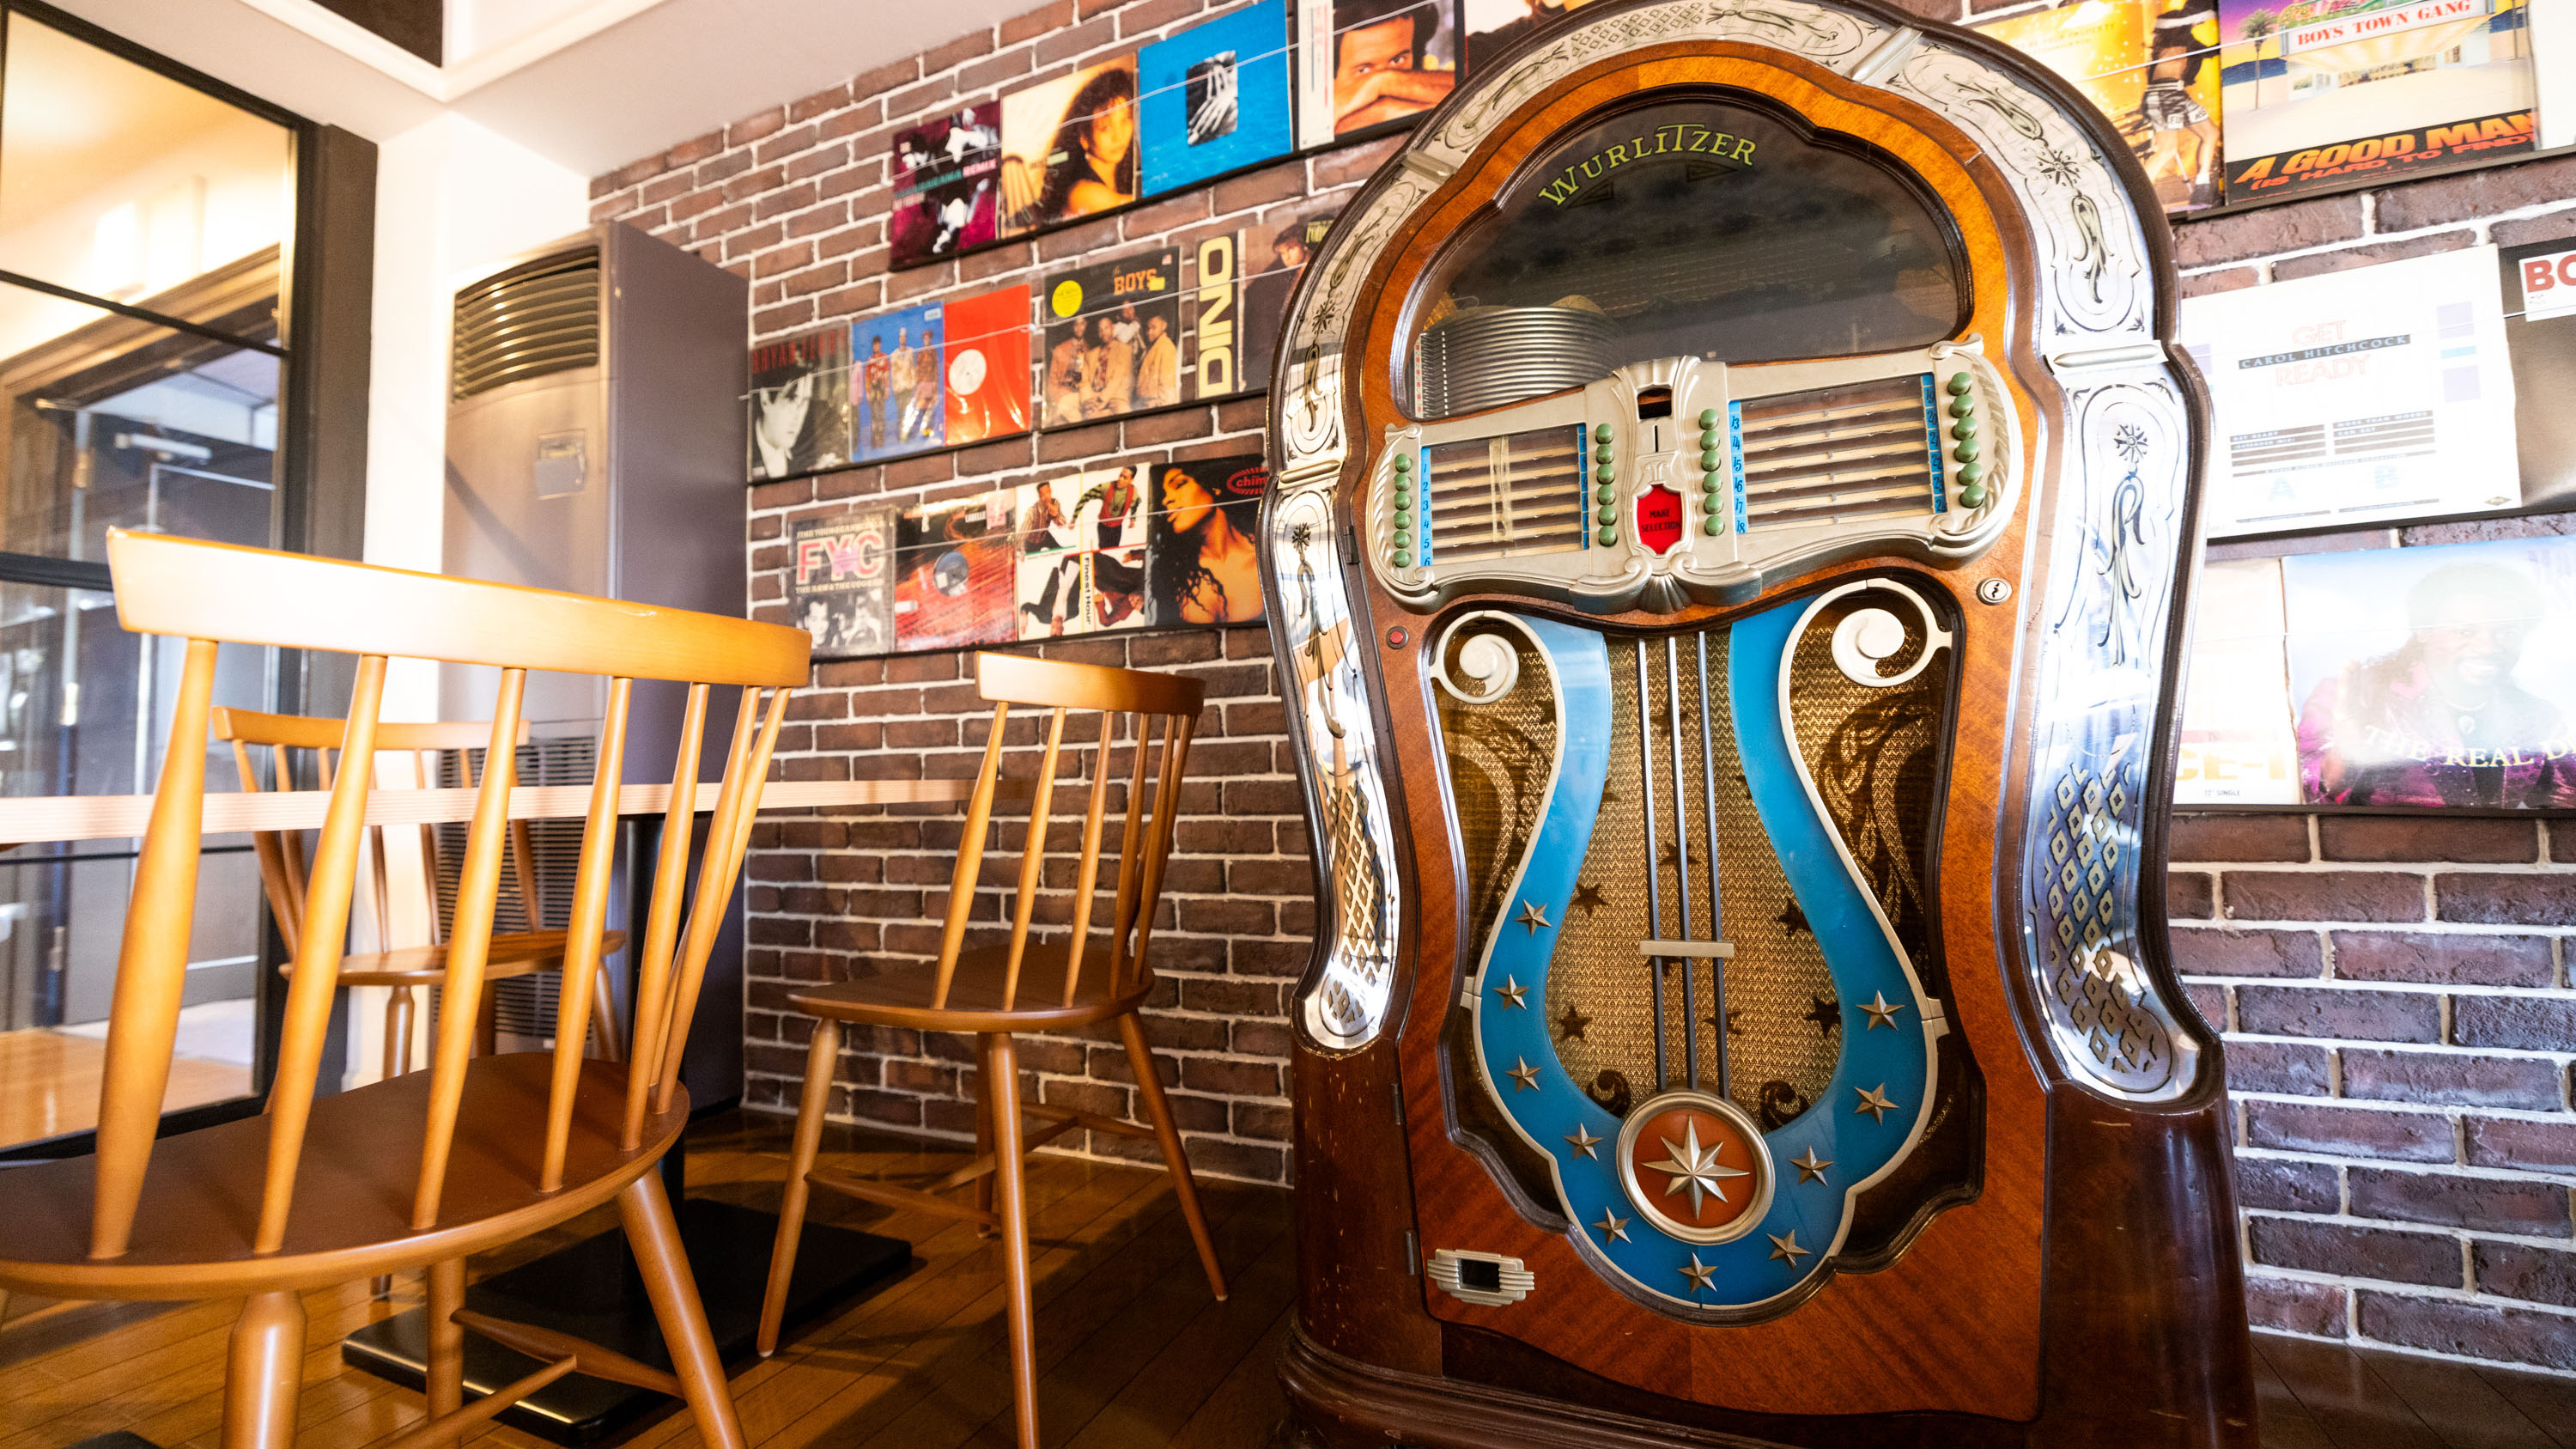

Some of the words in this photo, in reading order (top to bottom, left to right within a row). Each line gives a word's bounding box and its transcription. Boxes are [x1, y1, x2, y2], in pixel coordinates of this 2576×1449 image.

[2298, 26, 2344, 46] BOYS
[2351, 12, 2409, 34] TOWN
[2418, 0, 2470, 21] GANG
[2233, 156, 2276, 184] A
[2281, 133, 2416, 174] GOOD
[2397, 149, 2442, 163] TO
[1539, 125, 1757, 205] WURLITZER
[1114, 268, 1157, 295] BOYS
[1199, 236, 1232, 398] DINO
[2292, 320, 2346, 344] GET
[2241, 353, 2295, 368] CAROL
[2305, 336, 2407, 359] HITCHCOCK
[2276, 354, 2370, 387] READY
[1925, 389, 1935, 404] 19
[1731, 415, 1740, 430] 13
[1927, 411, 1937, 425] 20
[1732, 435, 1741, 450] 14
[1929, 432, 1939, 447] 21
[1424, 464, 1427, 473] 1
[1734, 456, 1742, 472] 15
[1423, 481, 1429, 492] 2
[1735, 477, 1743, 493] 16
[1423, 500, 1429, 511] 3
[1649, 508, 1670, 518] MAKE
[1735, 497, 1744, 514] 17
[1424, 520, 1430, 529] 4
[1641, 521, 1680, 532] SELECTION
[1736, 520, 1746, 534] 18
[1424, 539, 1430, 549] 5
[797, 530, 885, 584] FYC
[2366, 725, 2429, 761] THE
[2443, 746, 2534, 767] REAL
[2539, 737, 2576, 760] D
